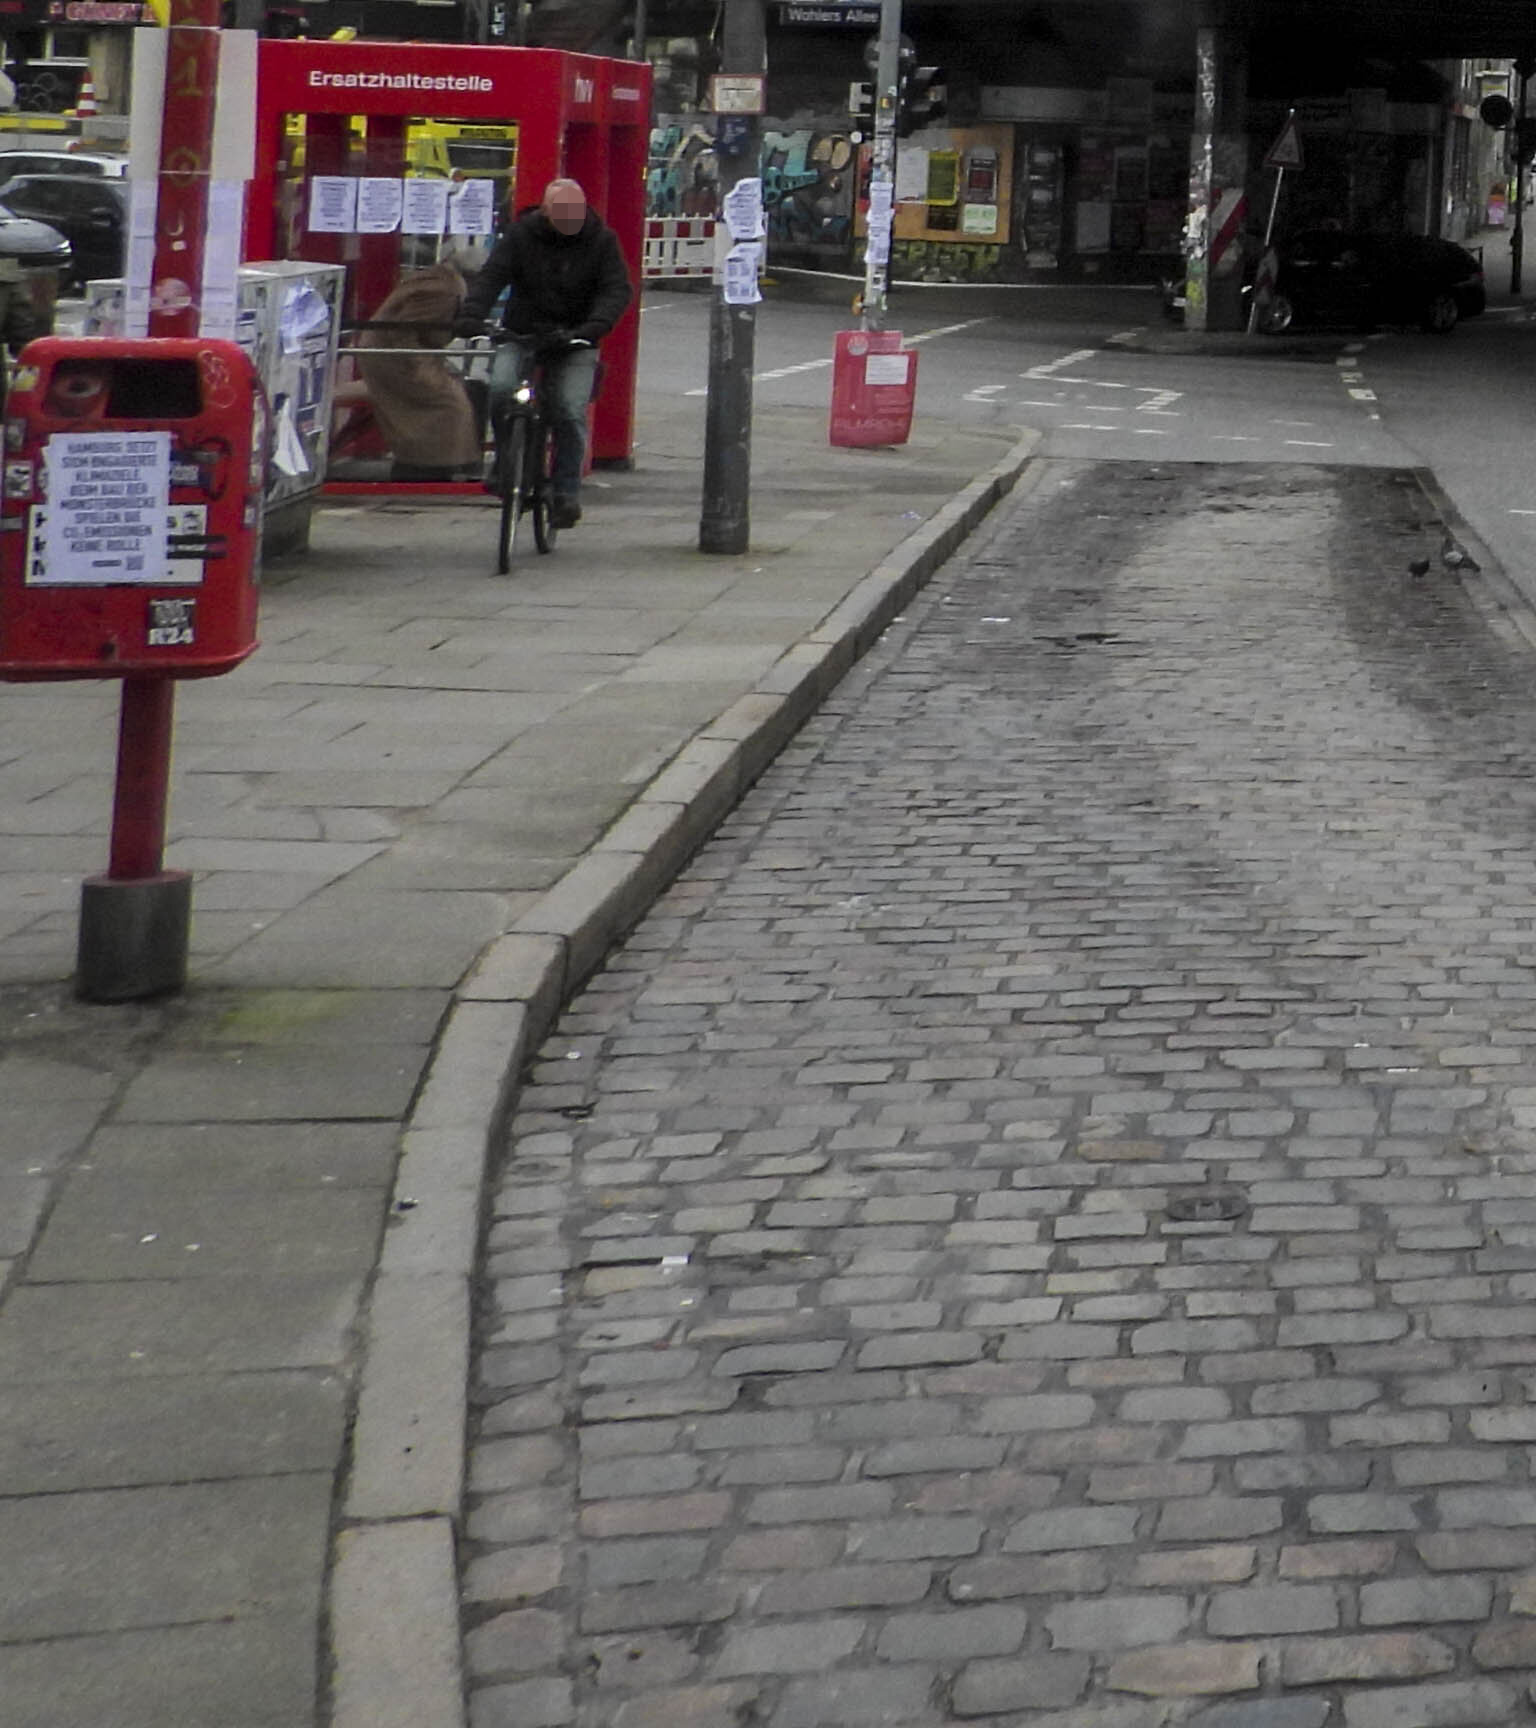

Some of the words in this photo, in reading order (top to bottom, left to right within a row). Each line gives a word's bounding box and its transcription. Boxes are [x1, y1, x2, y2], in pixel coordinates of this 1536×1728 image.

[788, 7, 841, 23] Wohlers
[846, 8, 880, 23] Allee
[309, 69, 493, 92] Ersatzhaltestelle
